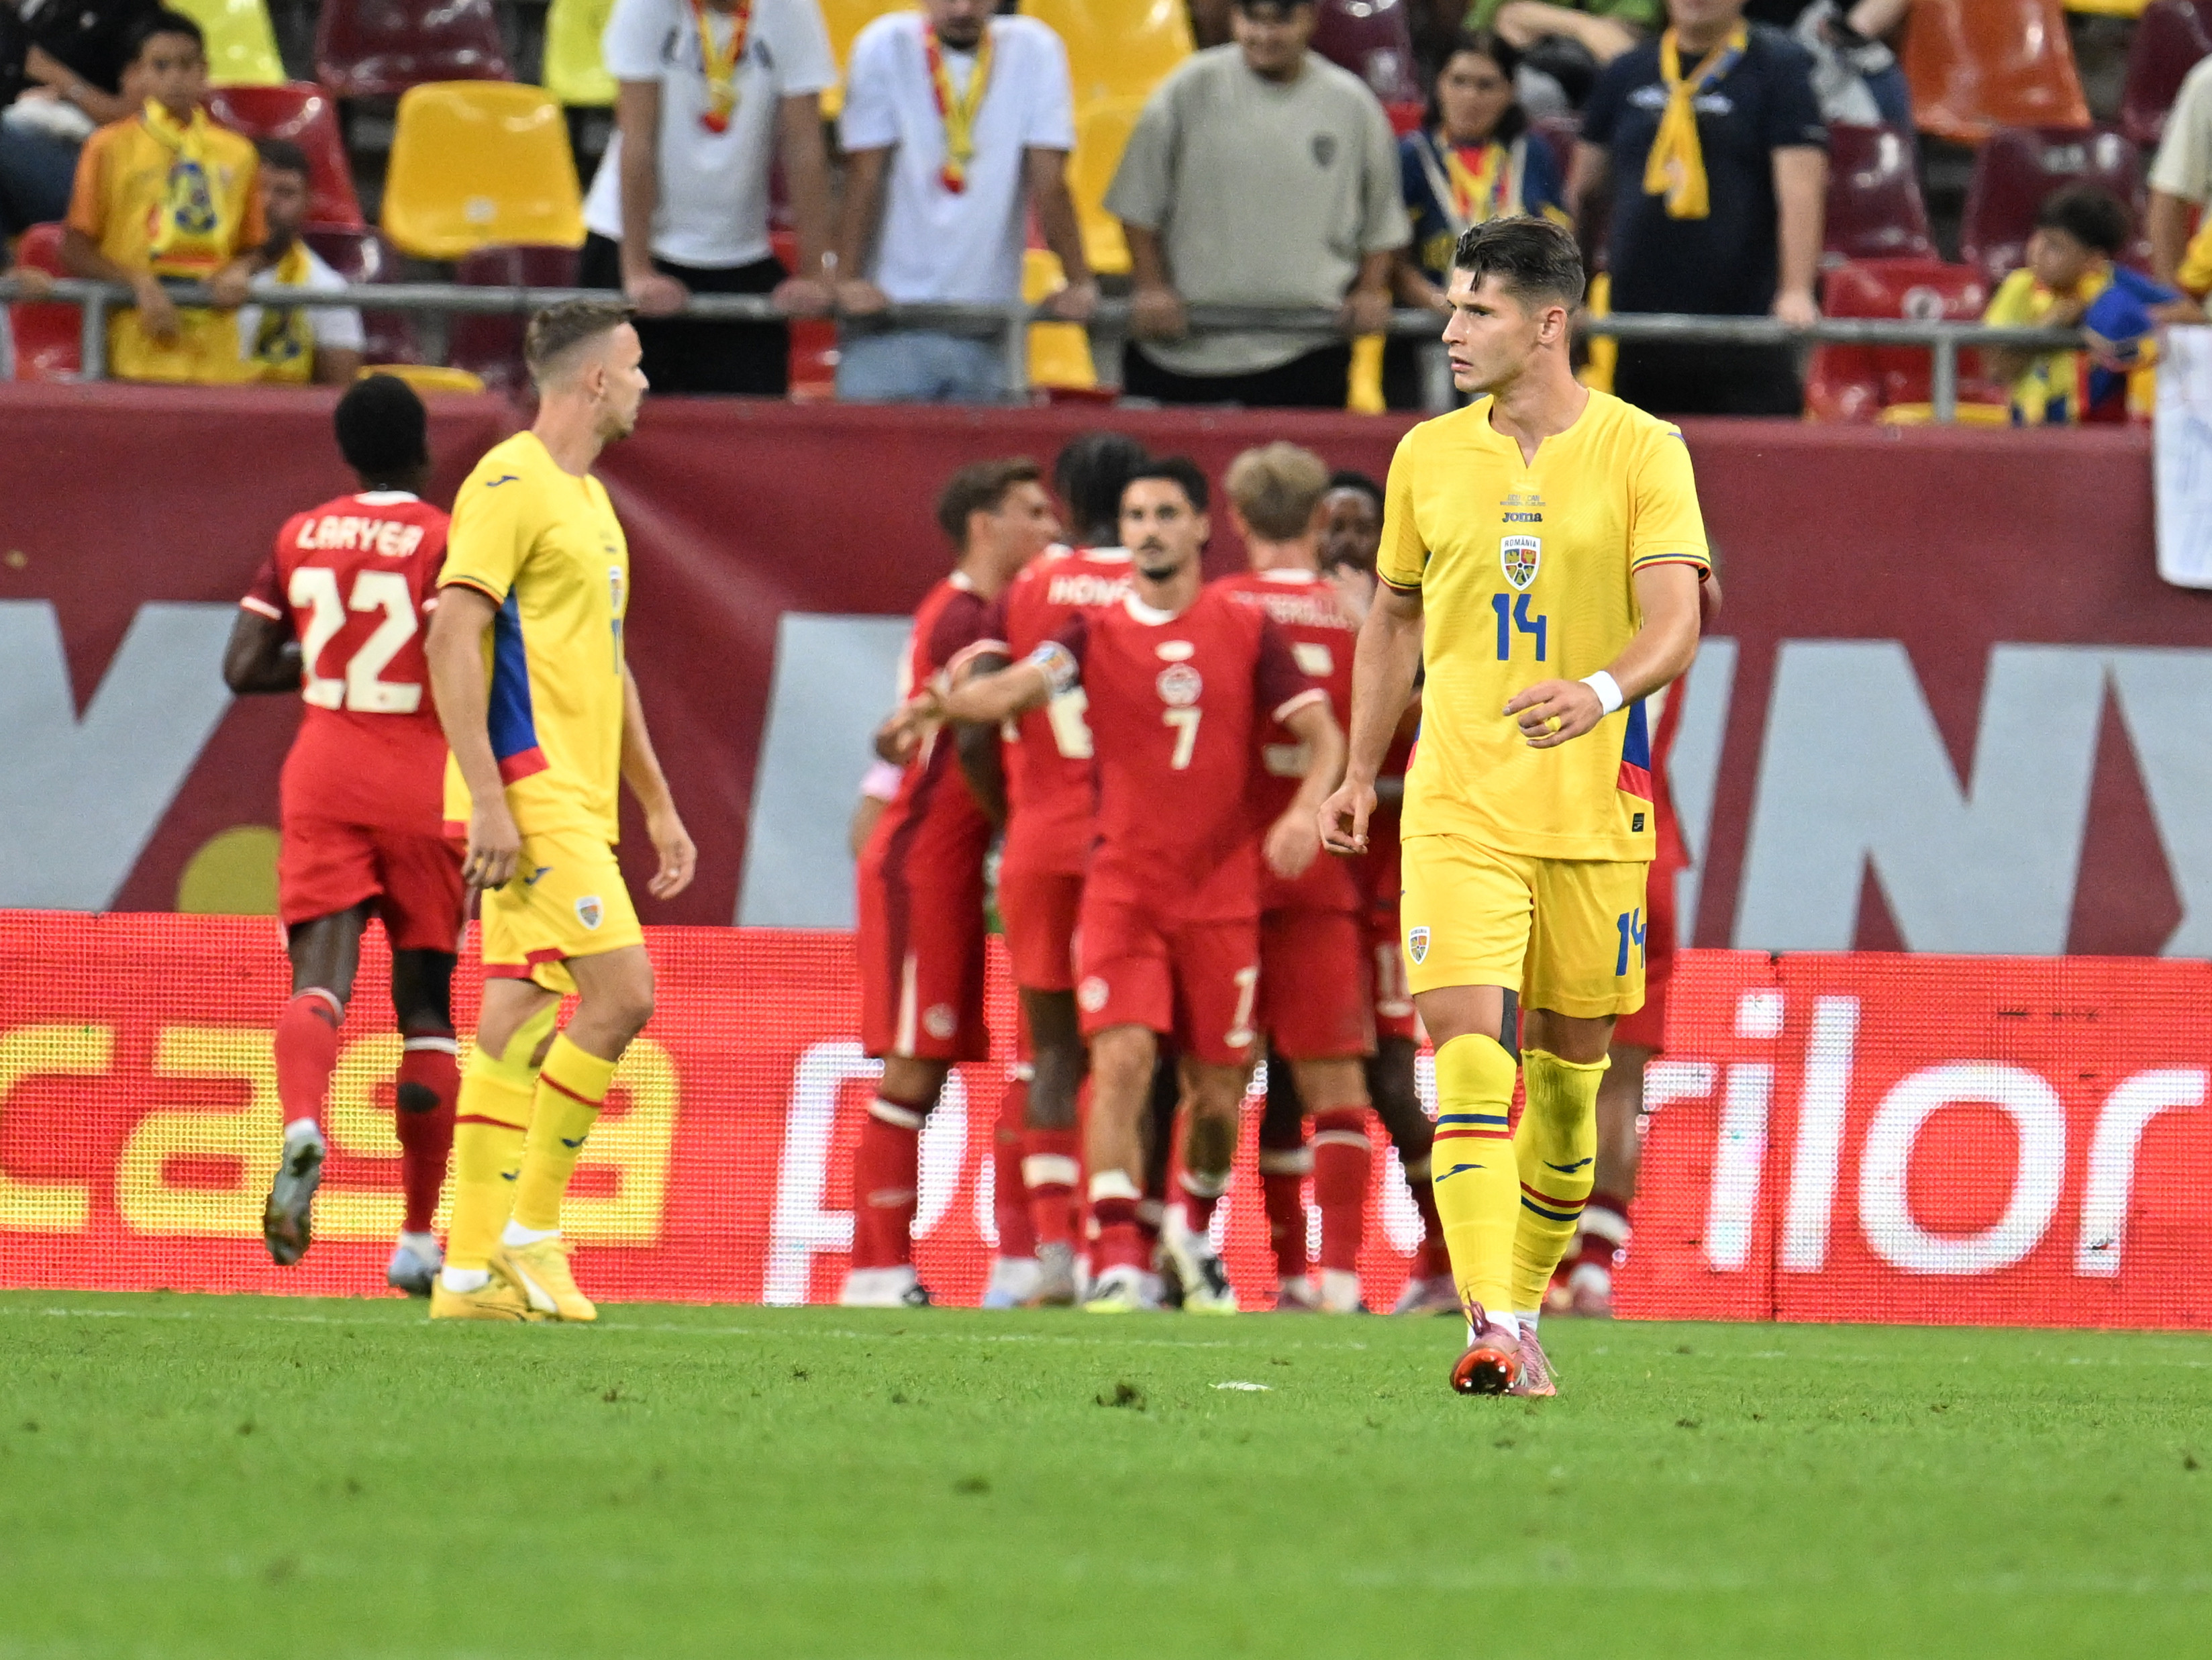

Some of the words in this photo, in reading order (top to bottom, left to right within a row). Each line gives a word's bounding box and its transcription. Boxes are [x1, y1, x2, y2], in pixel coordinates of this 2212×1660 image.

[288, 566, 423, 714] 22
[1491, 593, 1547, 661] 14
[1162, 706, 1203, 770] 7
[1616, 908, 1646, 976] 14
